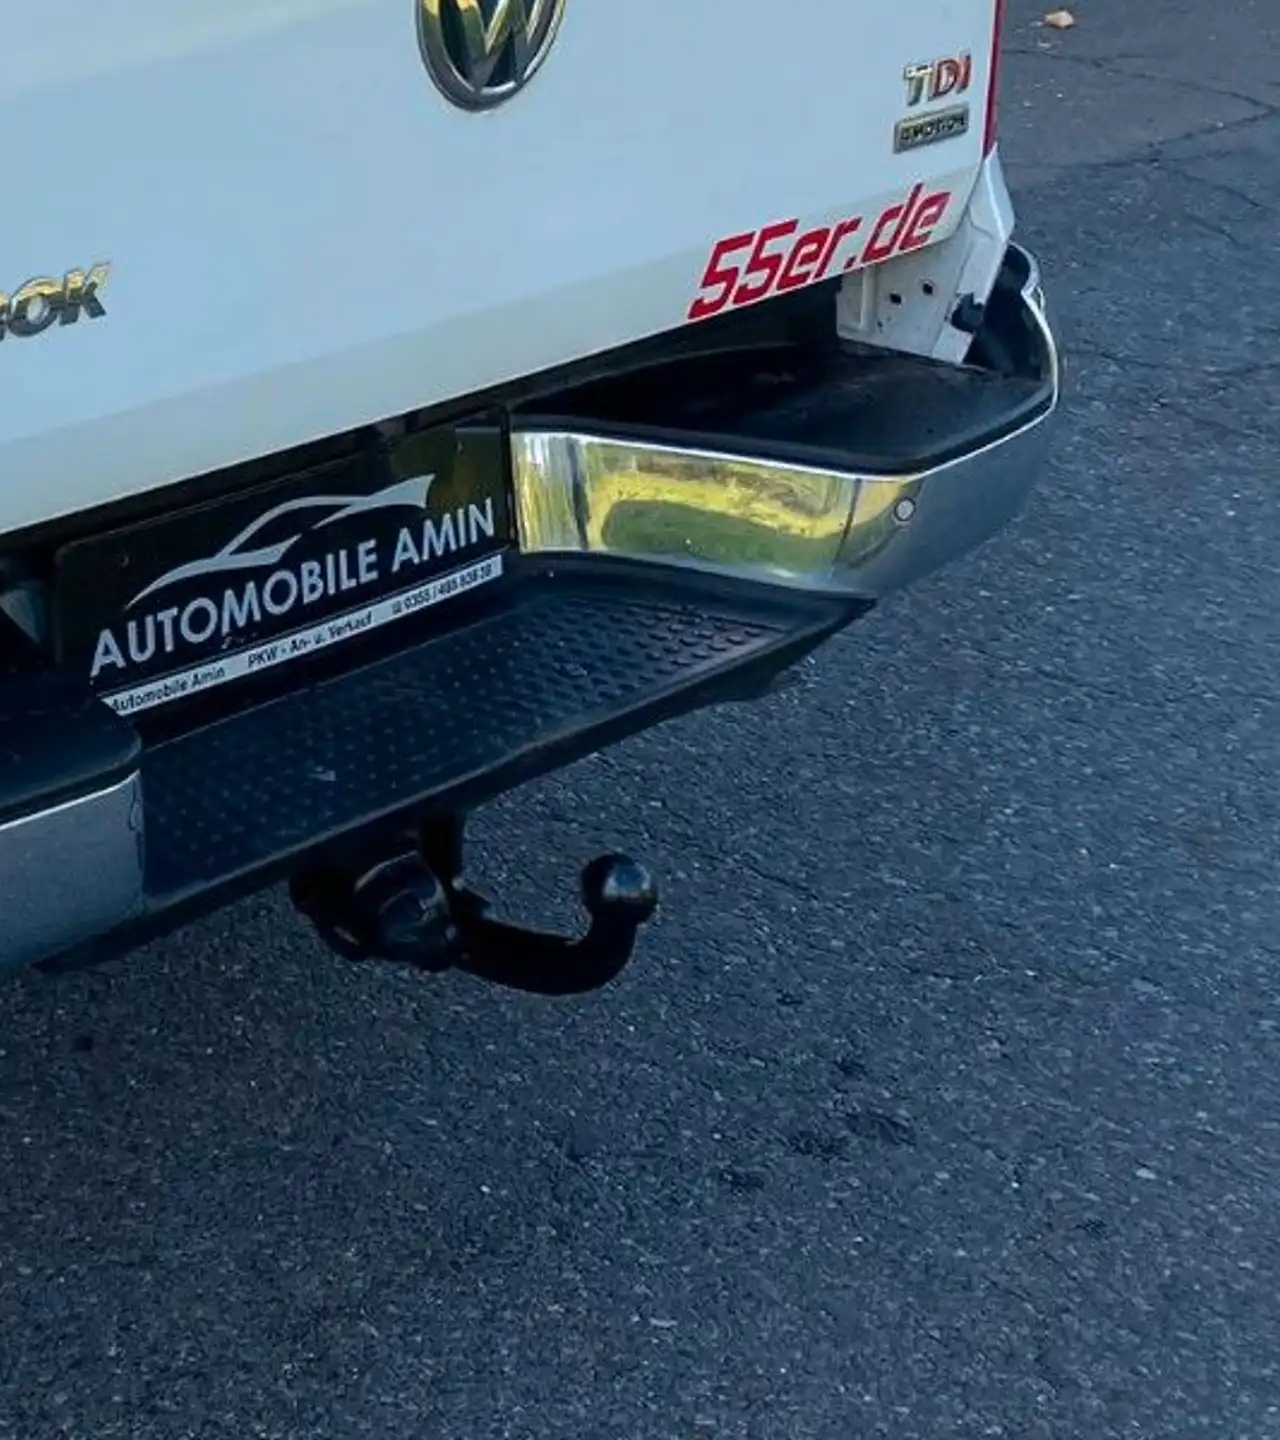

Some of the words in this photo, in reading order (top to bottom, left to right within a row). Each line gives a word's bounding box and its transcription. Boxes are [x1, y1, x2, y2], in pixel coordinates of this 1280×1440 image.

[903, 53, 972, 106] TDI
[687, 181, 952, 320] 55er.de
[91, 538, 378, 678] AUTOMOBILE
[391, 498, 495, 572] AMIN
[247, 645, 278, 668] PKW
[112, 679, 188, 712] Automobile
[190, 665, 226, 688] Amin
